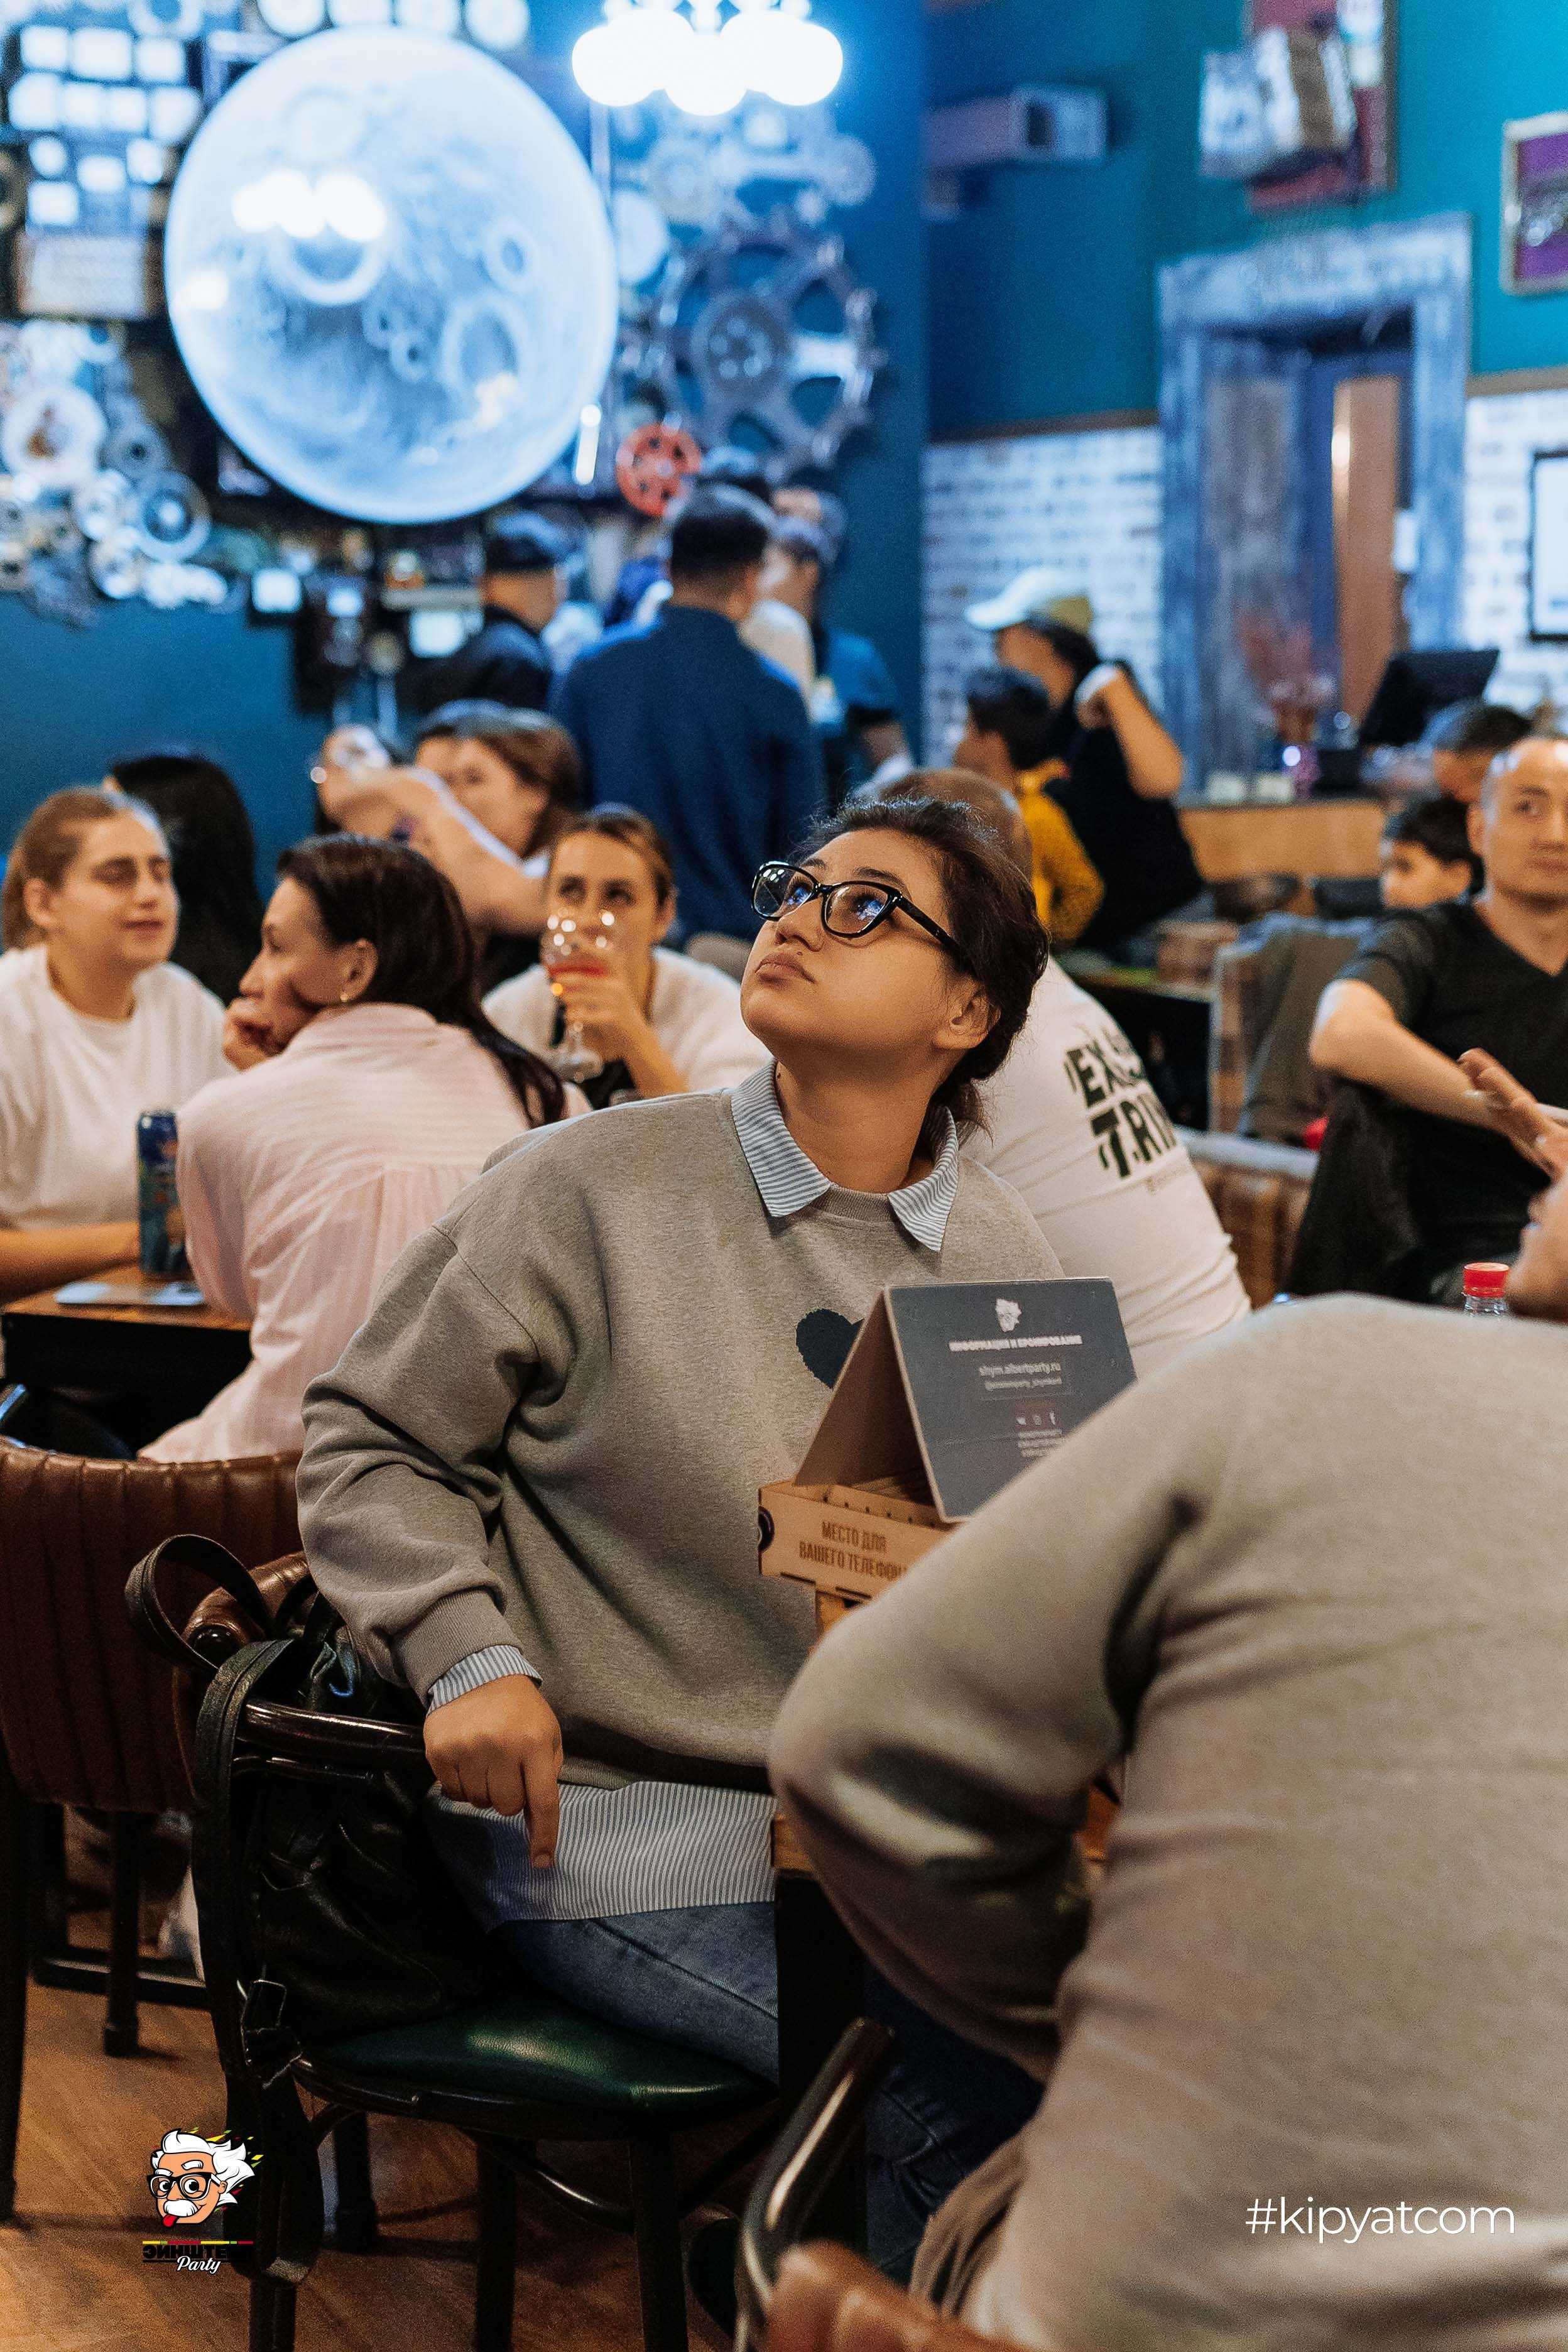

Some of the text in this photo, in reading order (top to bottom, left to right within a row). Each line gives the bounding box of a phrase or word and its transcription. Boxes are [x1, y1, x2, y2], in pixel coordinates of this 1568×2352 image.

[822, 1522, 886, 1553] МЕСТО ДЛЯ
[799, 1541, 845, 1569] ВАШЕГО
